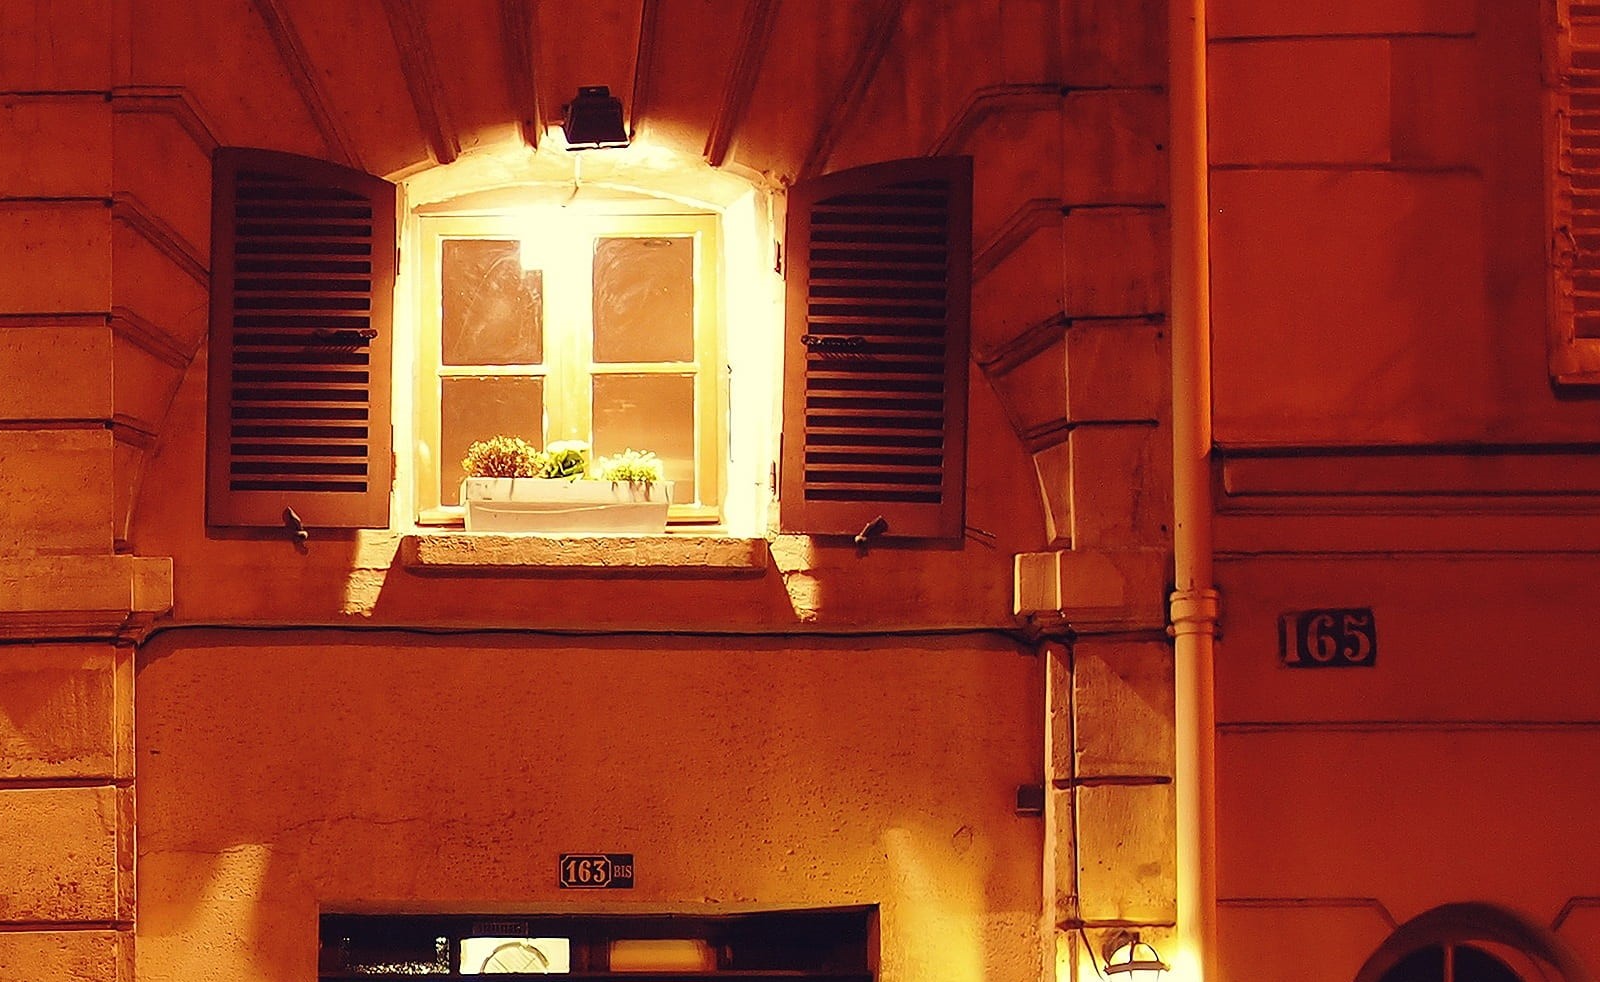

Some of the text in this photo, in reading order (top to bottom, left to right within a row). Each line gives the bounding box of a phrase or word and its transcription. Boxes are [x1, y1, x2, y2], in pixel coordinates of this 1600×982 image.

[1284, 613, 1371, 662] 165
[566, 859, 632, 883] 163 BIS
